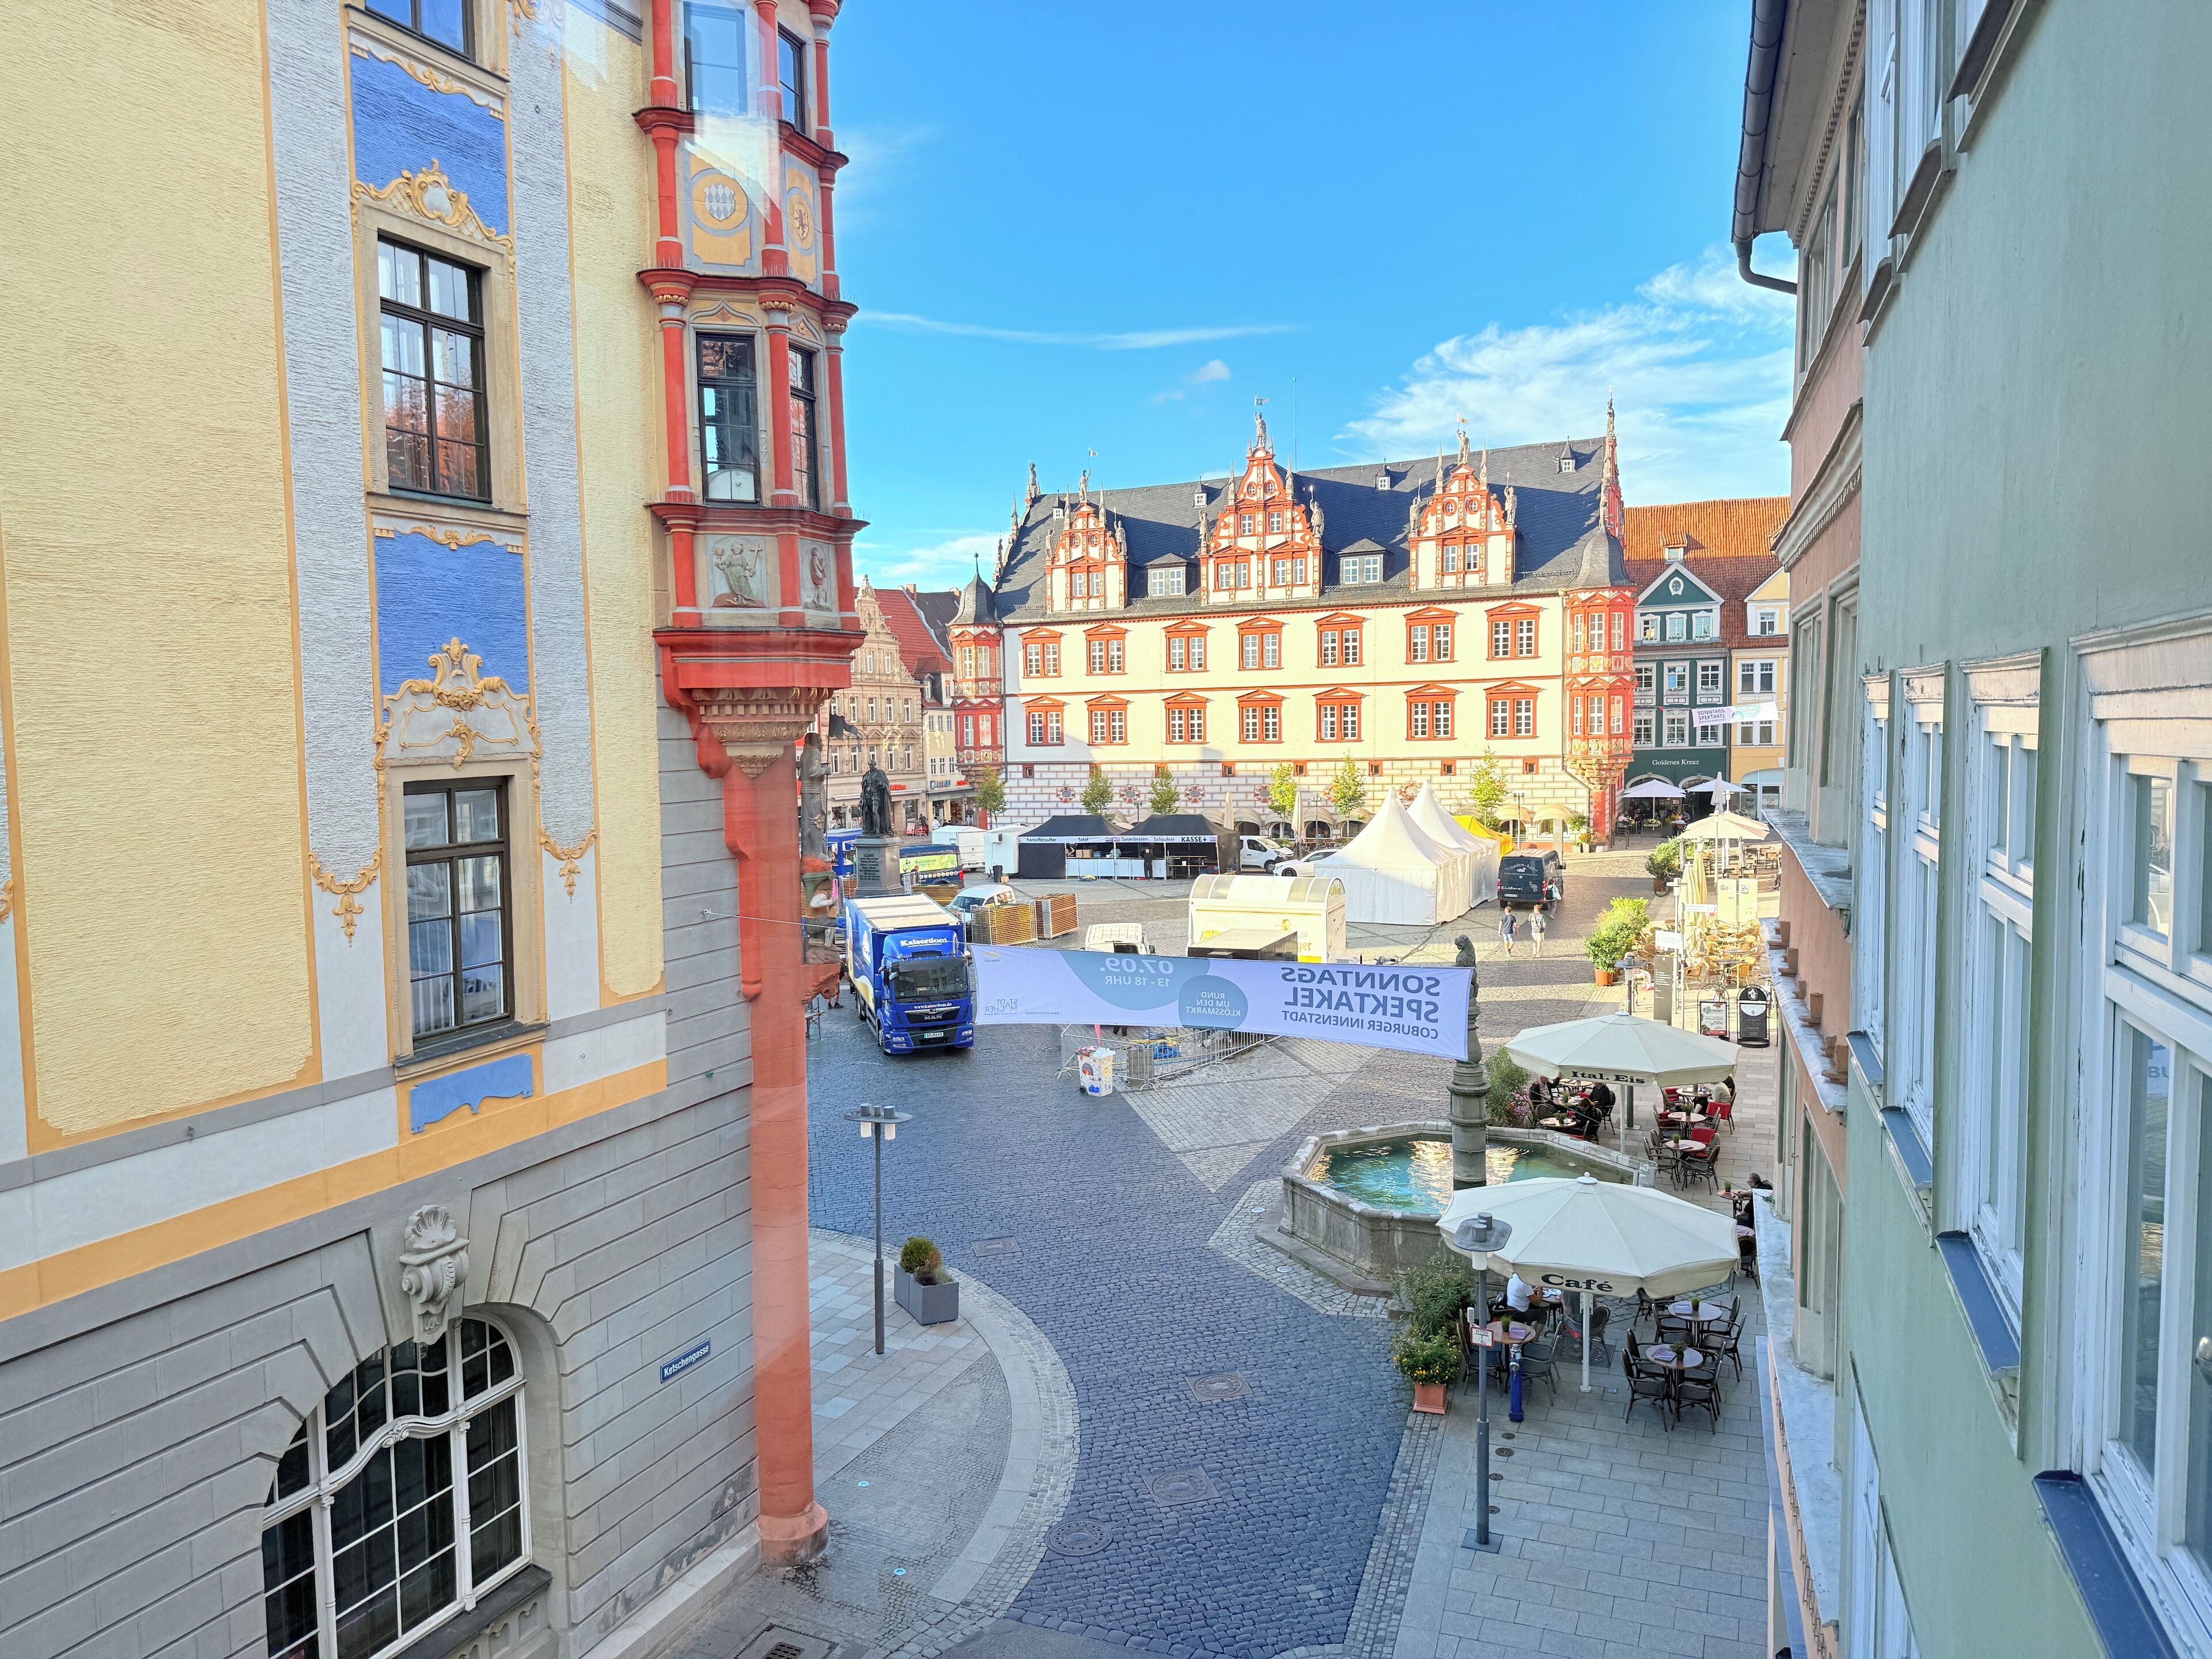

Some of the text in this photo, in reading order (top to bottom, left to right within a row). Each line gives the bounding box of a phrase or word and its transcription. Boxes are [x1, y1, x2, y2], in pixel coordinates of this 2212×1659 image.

[900, 938, 948, 946] Kaiserdom
[1571, 1071, 1645, 1084] Ital. Eis
[1541, 1274, 1613, 1292] Café
[664, 1345, 709, 1377] Ketschengasse
